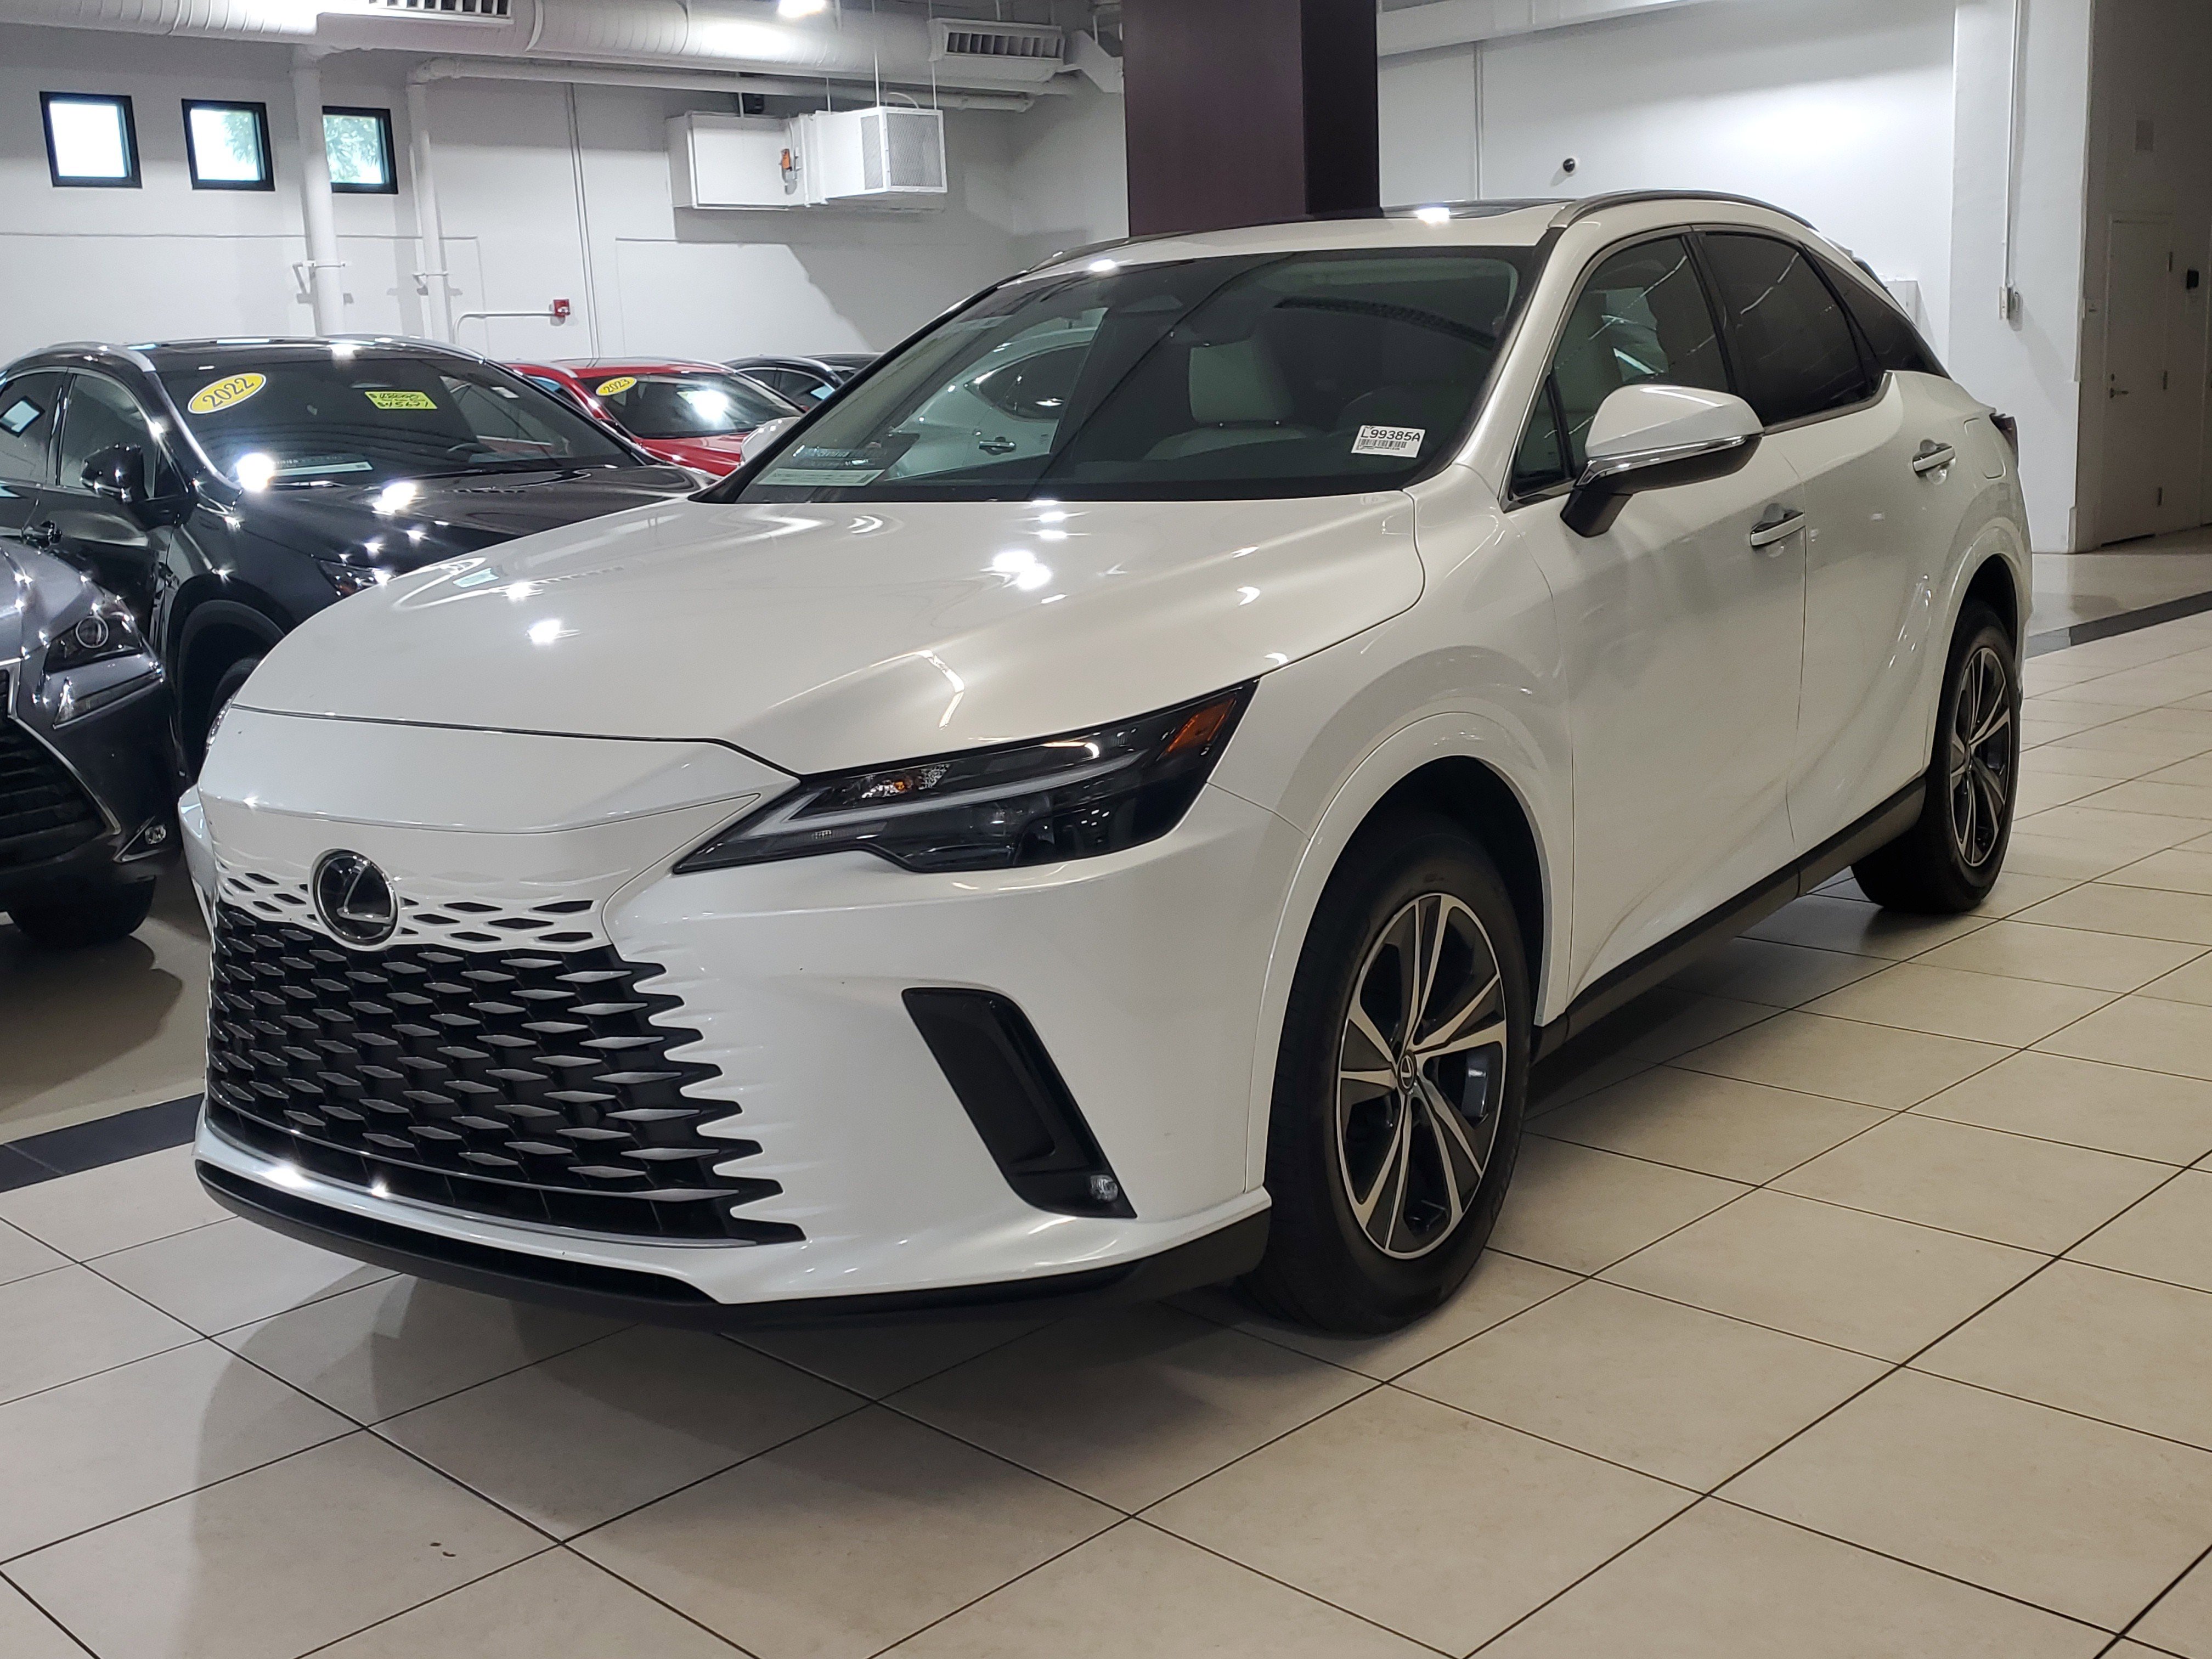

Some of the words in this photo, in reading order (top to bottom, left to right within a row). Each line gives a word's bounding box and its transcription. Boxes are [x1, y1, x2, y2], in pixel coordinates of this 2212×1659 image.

[202, 377, 255, 408] 2022
[603, 379, 630, 393] 2023
[1361, 428, 1421, 442] L99385A
